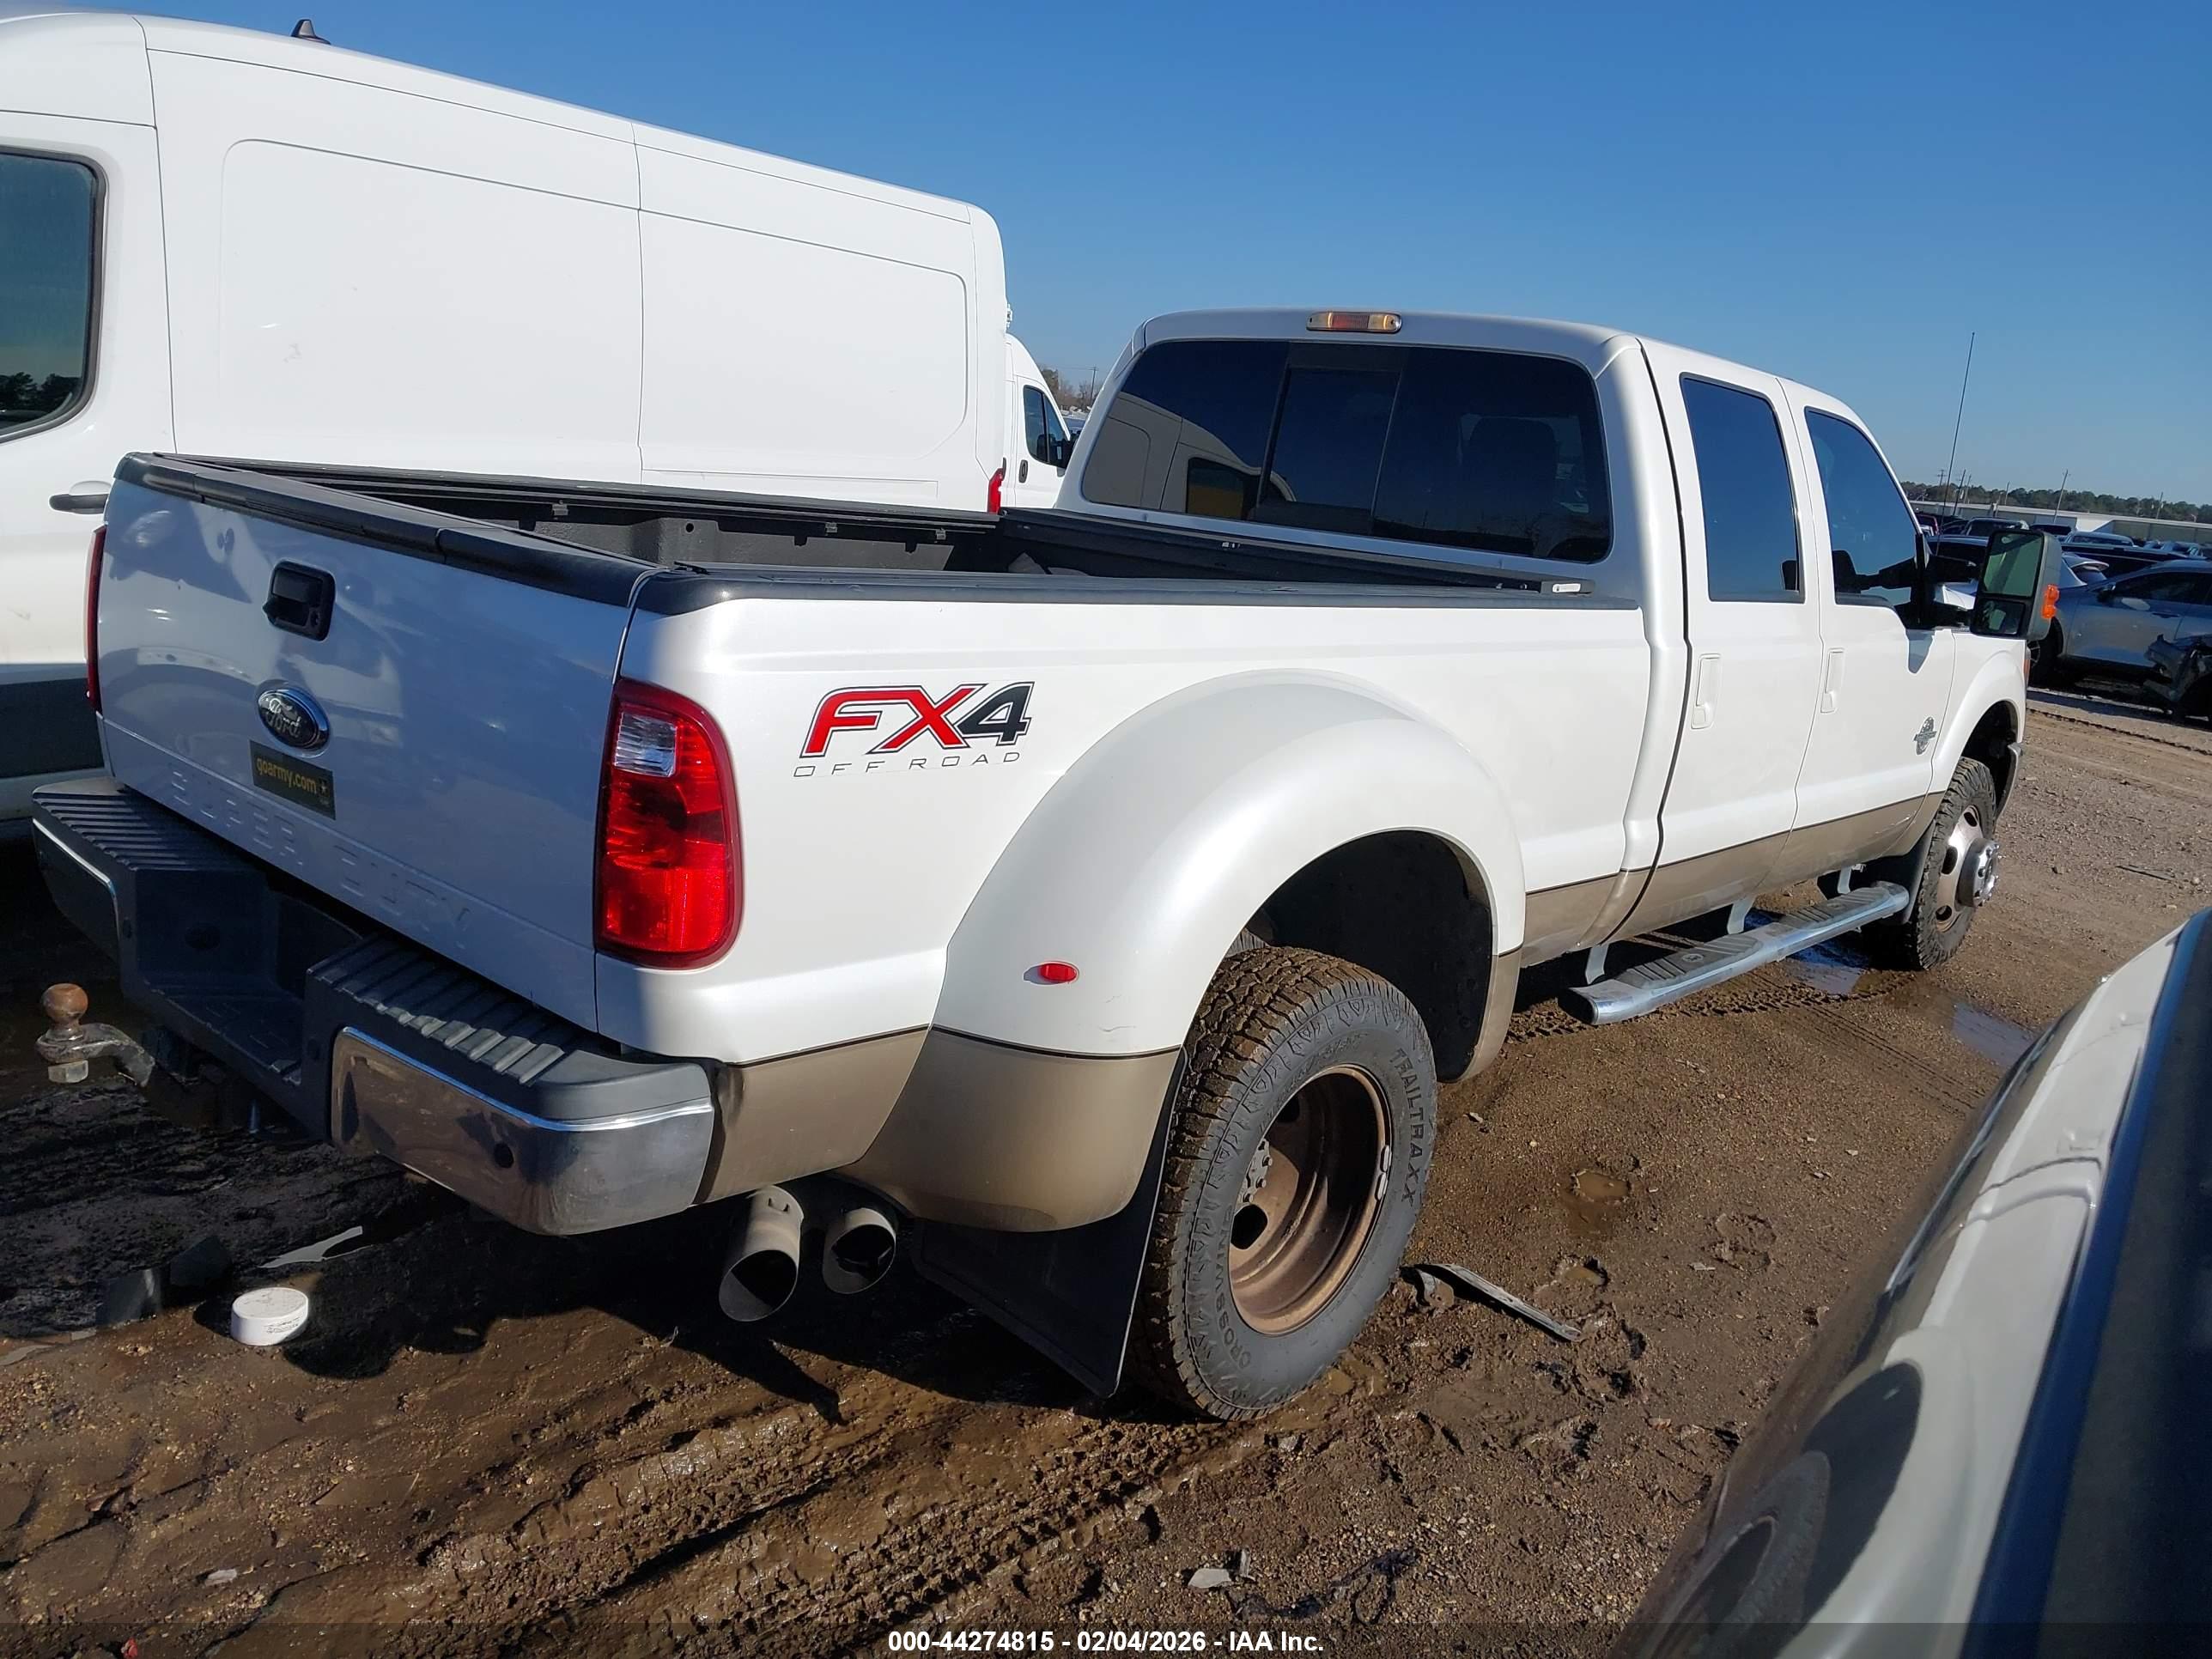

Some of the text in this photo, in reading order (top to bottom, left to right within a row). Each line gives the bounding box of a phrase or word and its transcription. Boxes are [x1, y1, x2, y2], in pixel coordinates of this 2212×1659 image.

[264, 697, 302, 738] Ford
[799, 681, 1035, 759] FX4
[256, 757, 318, 795] goarmy.com
[793, 751, 1020, 778] OFF ROAD
[1389, 1047, 1425, 1207] TRAILTRAXX
